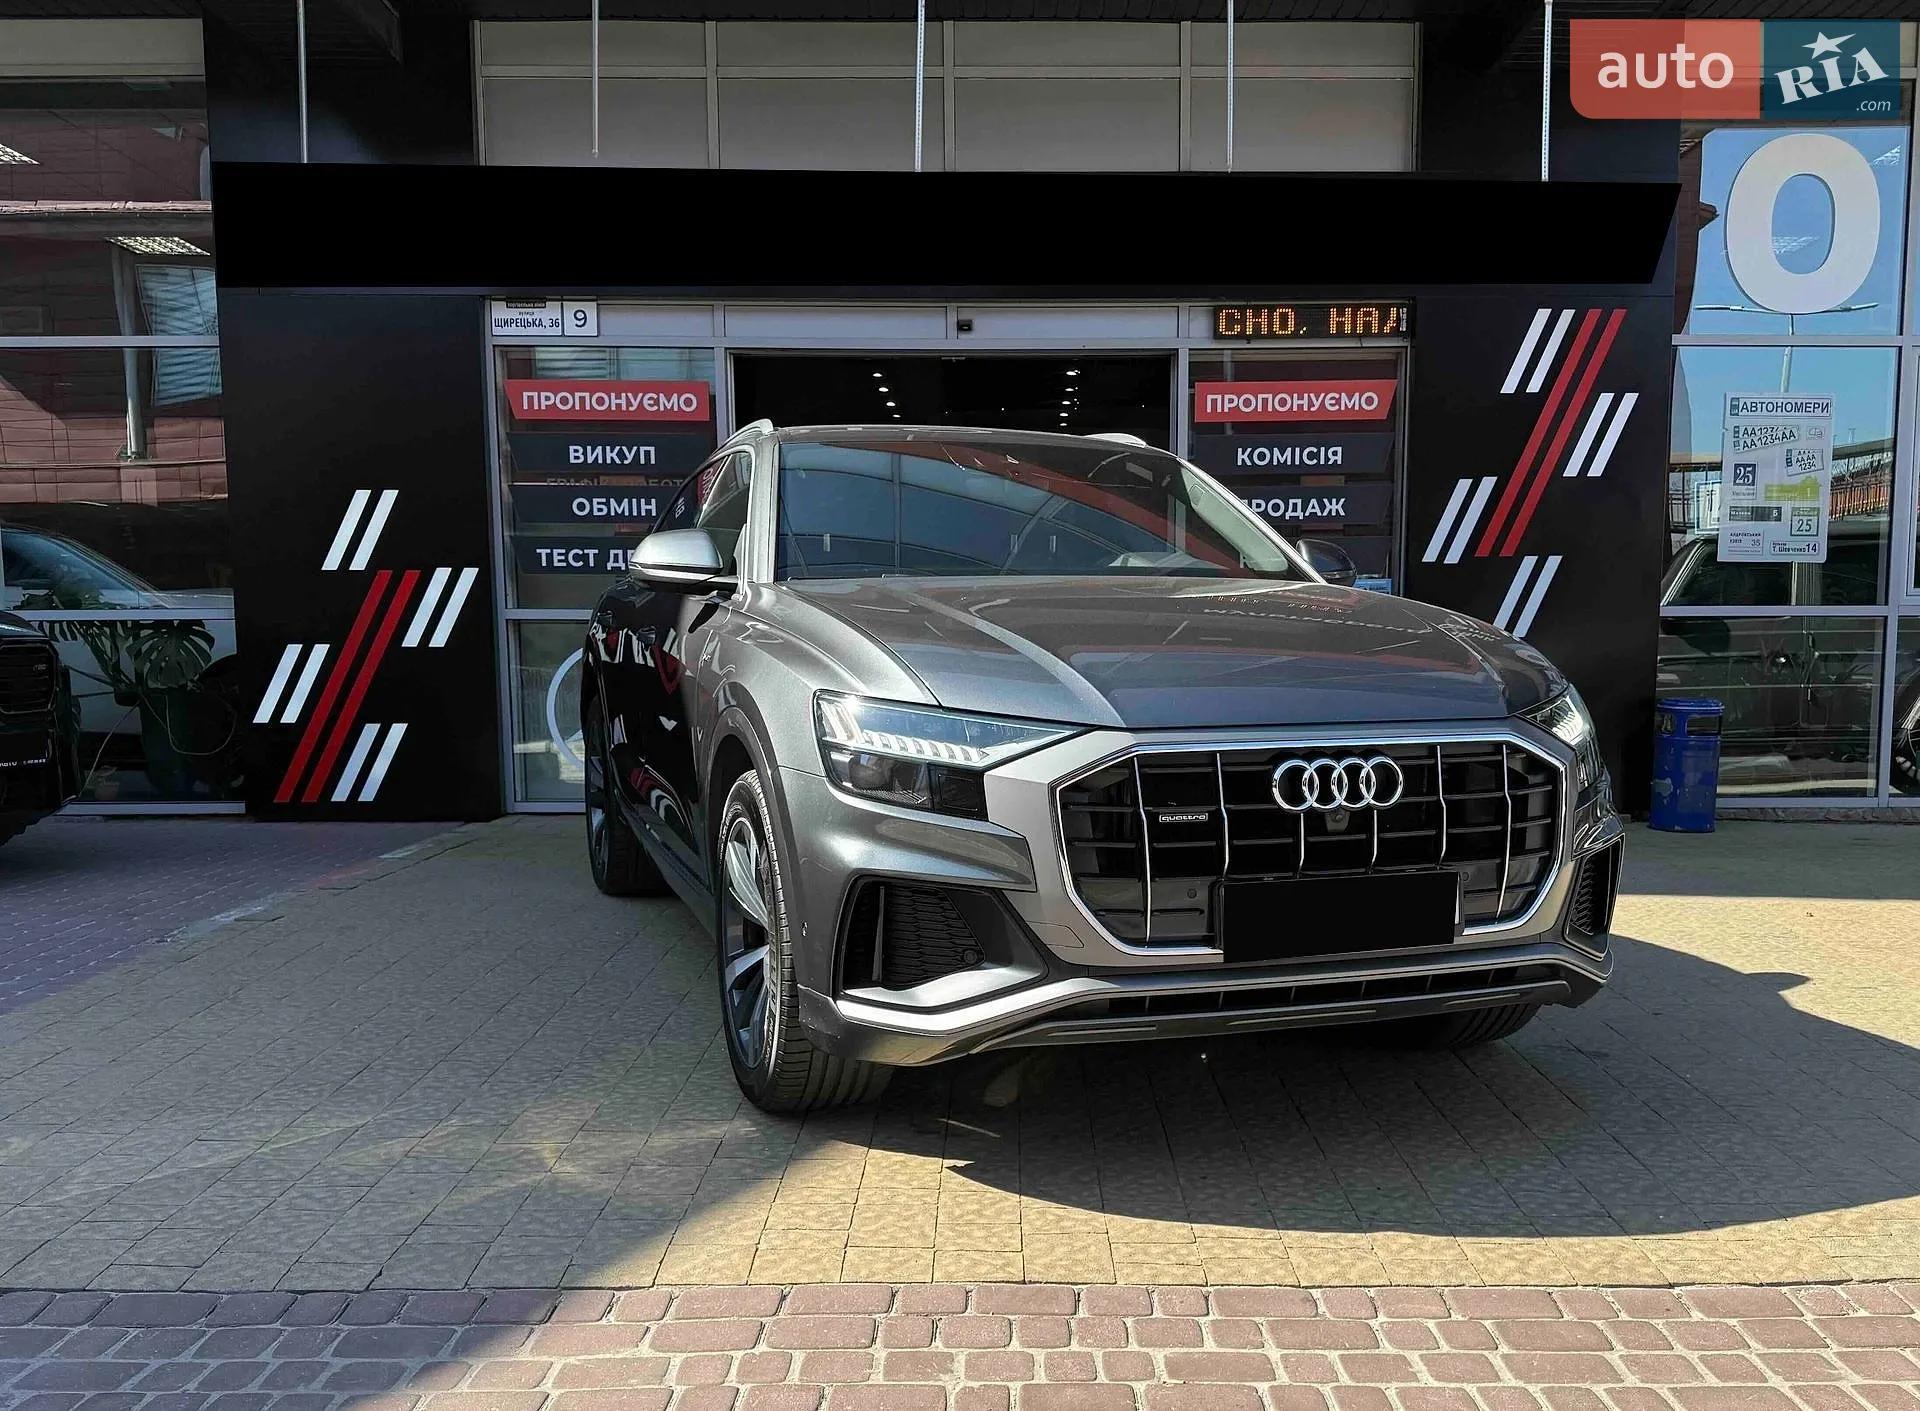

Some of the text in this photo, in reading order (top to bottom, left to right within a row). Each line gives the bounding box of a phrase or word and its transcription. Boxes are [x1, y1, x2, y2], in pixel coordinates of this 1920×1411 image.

[494, 317, 560, 329] ЩИРЕЦЬКА, 36
[573, 309, 588, 328] 9
[522, 391, 697, 412] ПРОПОНУЄМО
[1206, 392, 1378, 412] ПРОПОНУЄМО
[1740, 402, 1829, 414] АВТОНОМЕРИ
[568, 445, 656, 465] ВИКУП
[1236, 446, 1342, 465] КОМІСІЯ
[1735, 466, 1753, 485] 25
[572, 497, 657, 517] ОБМІН
[1796, 518, 1813, 533] 25
[536, 548, 598, 567] ТЕСТ
[1806, 543, 1817, 553] 14
